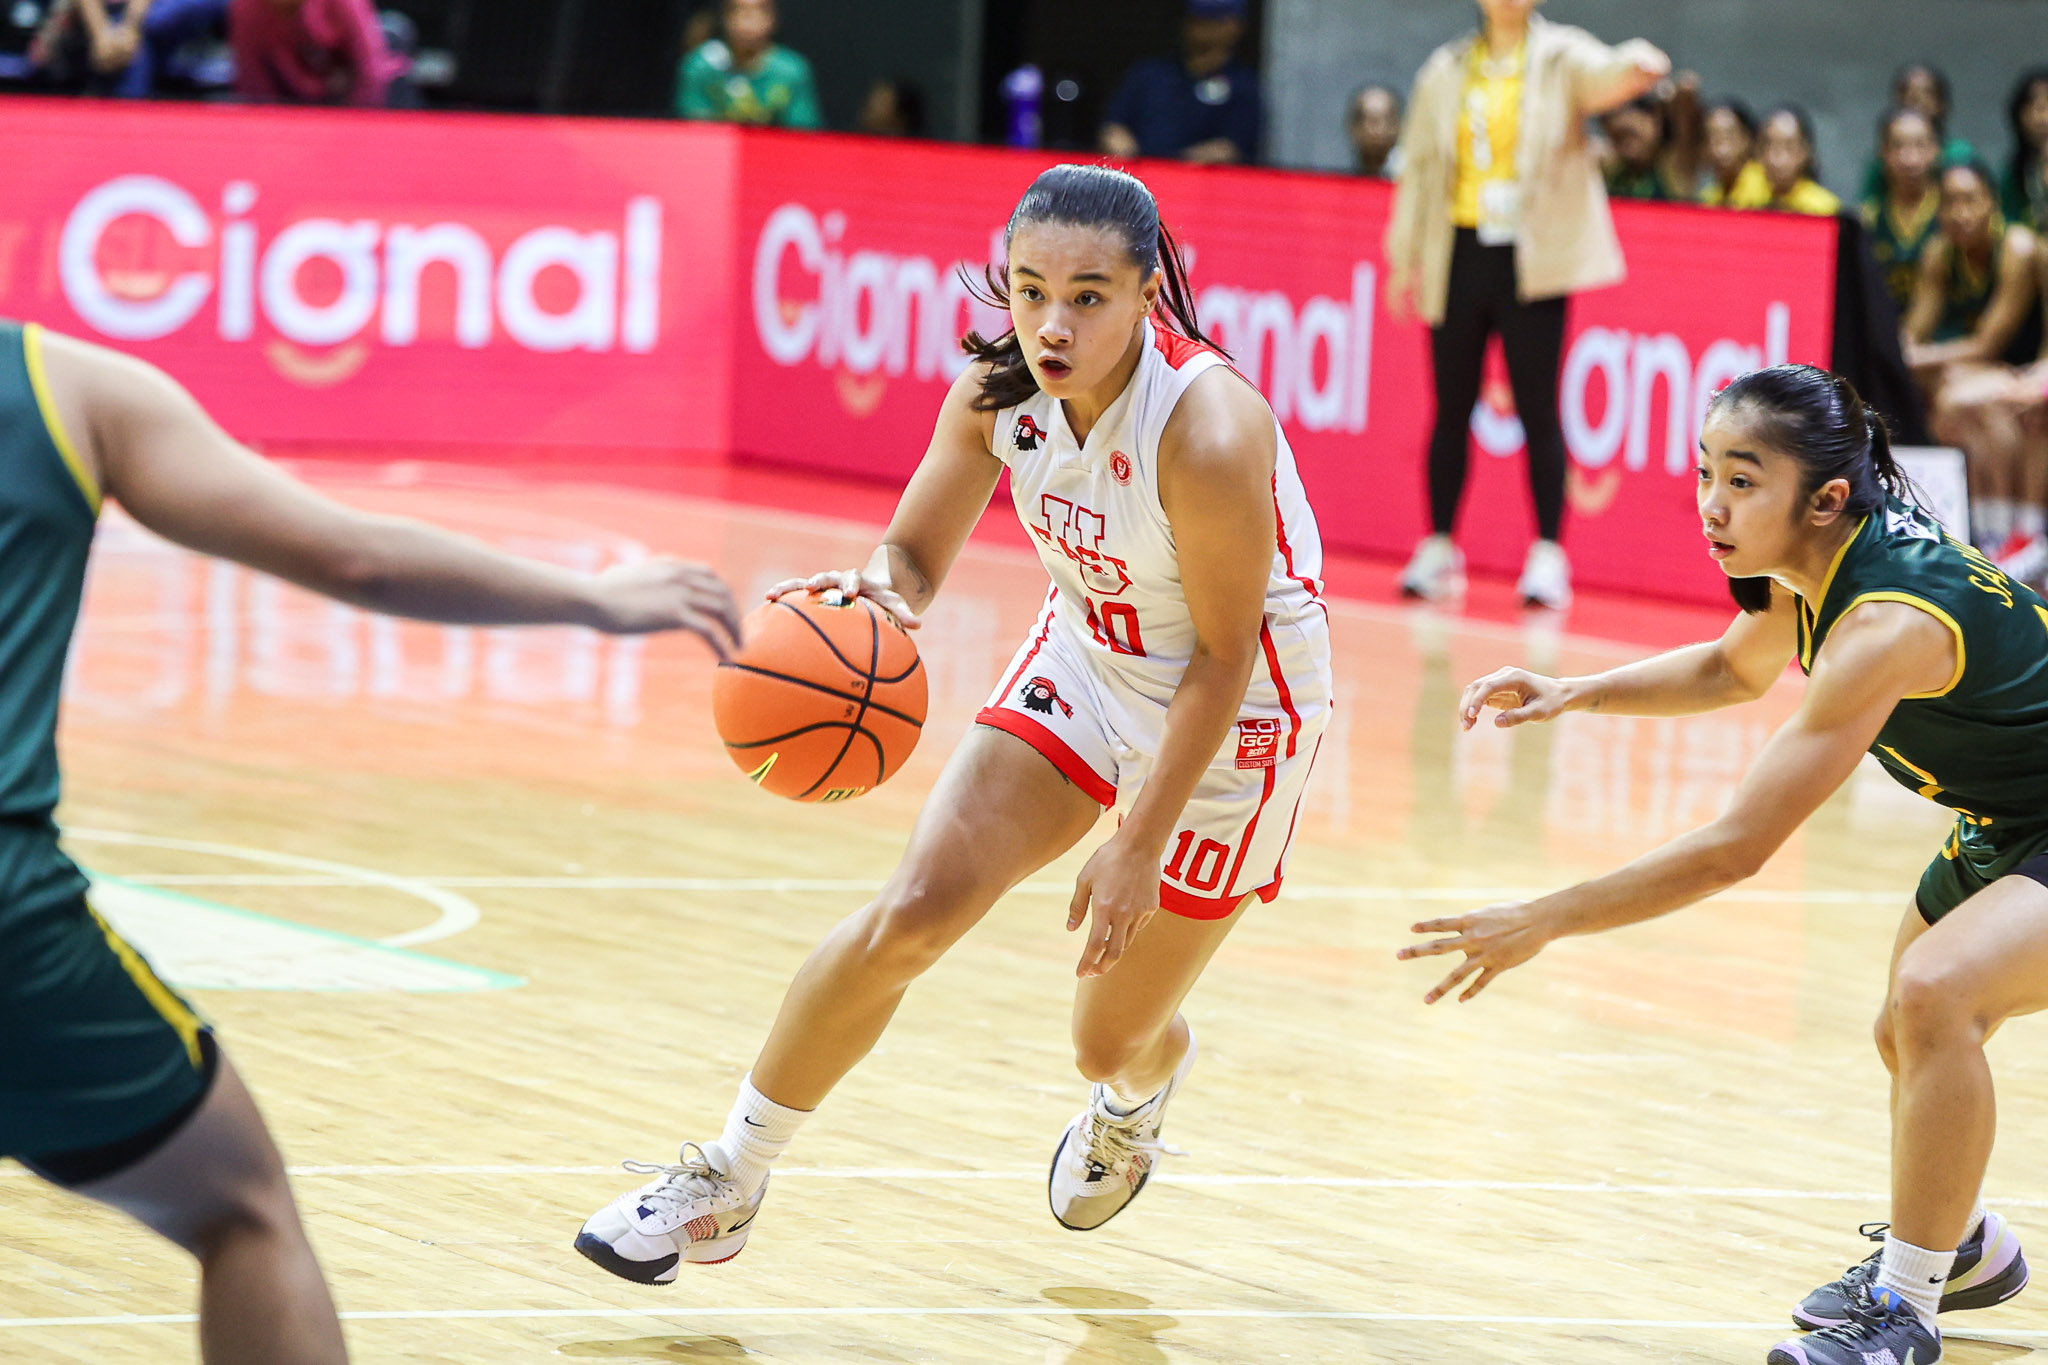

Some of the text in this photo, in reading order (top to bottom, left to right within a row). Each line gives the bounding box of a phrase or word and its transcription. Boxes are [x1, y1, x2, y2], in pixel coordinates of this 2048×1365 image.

[59, 174, 663, 354] Cignal
[1086, 596, 1147, 658] 10
[1238, 759, 1274, 769] CUSTOM SIZE
[1163, 829, 1231, 892] 10
